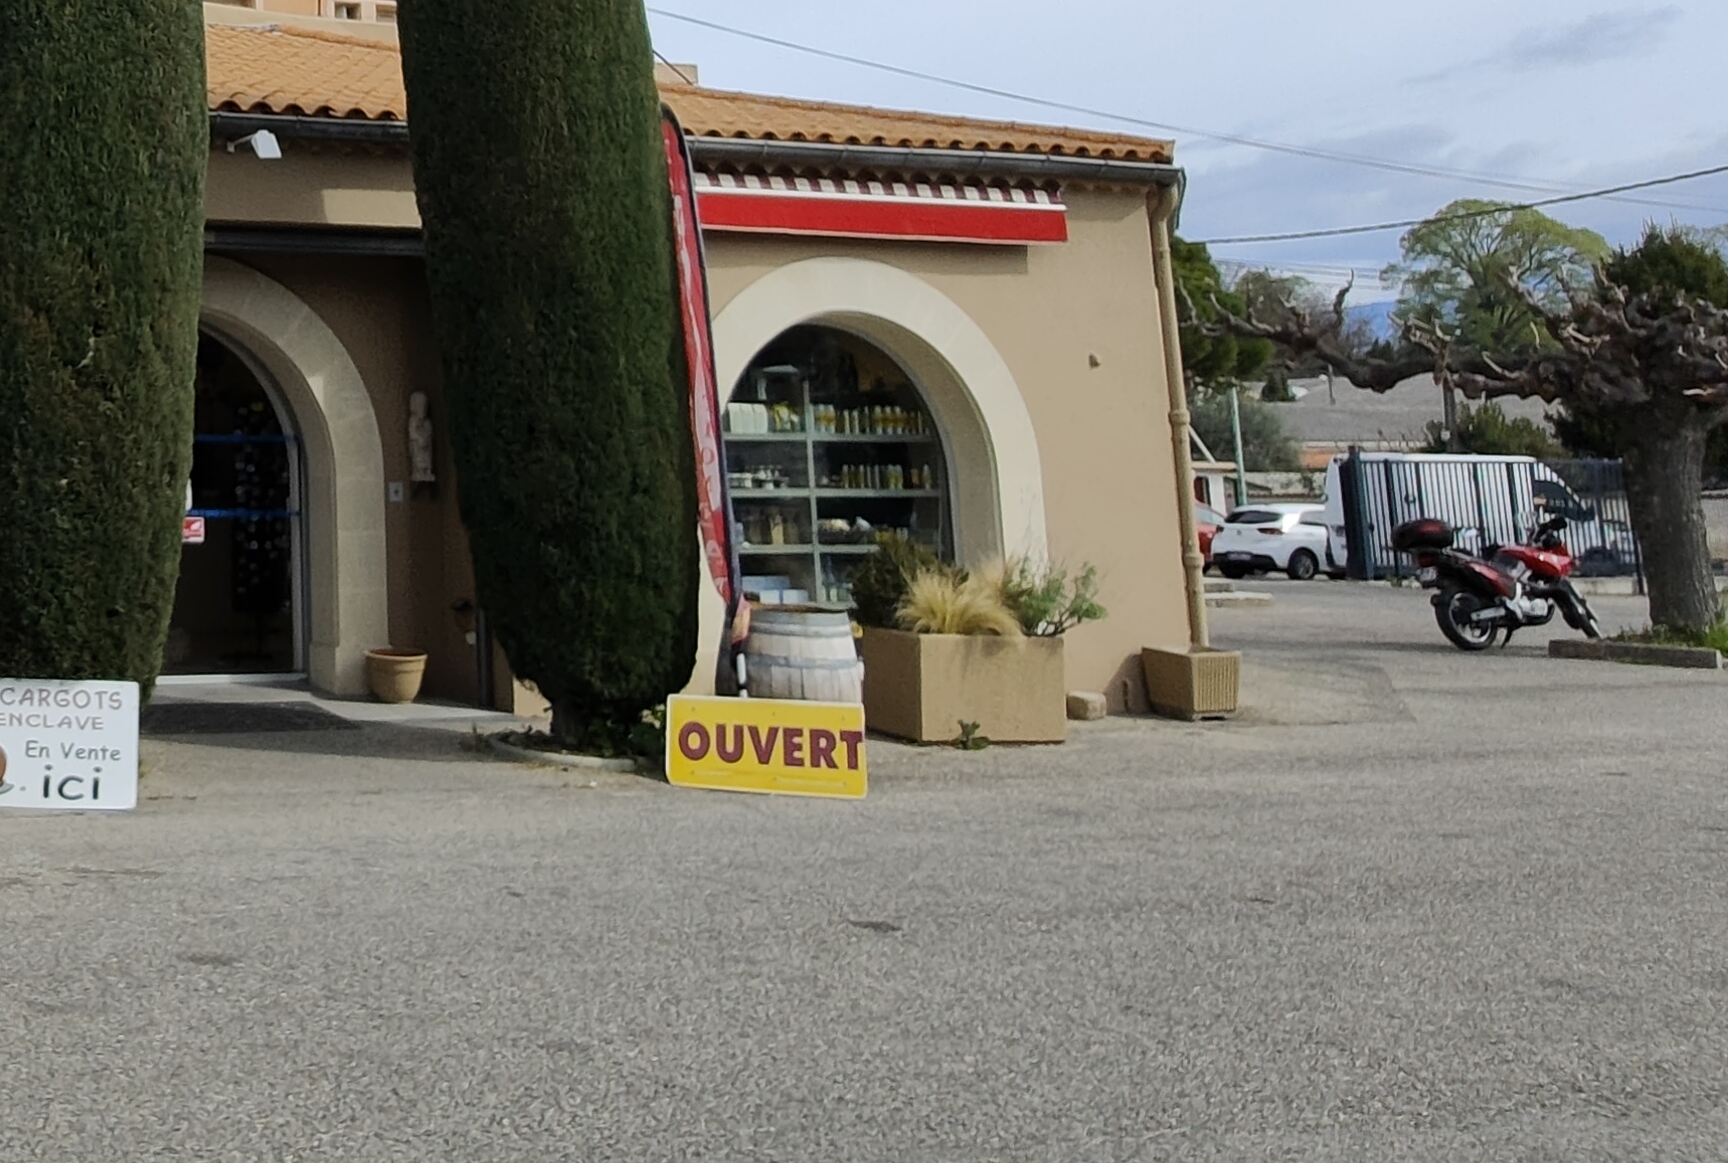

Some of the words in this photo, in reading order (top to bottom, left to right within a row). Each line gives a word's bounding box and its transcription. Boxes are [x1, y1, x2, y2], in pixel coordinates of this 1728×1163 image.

[24, 740, 51, 759] En
[60, 742, 122, 762] Vente
[678, 721, 863, 771] OUVERT
